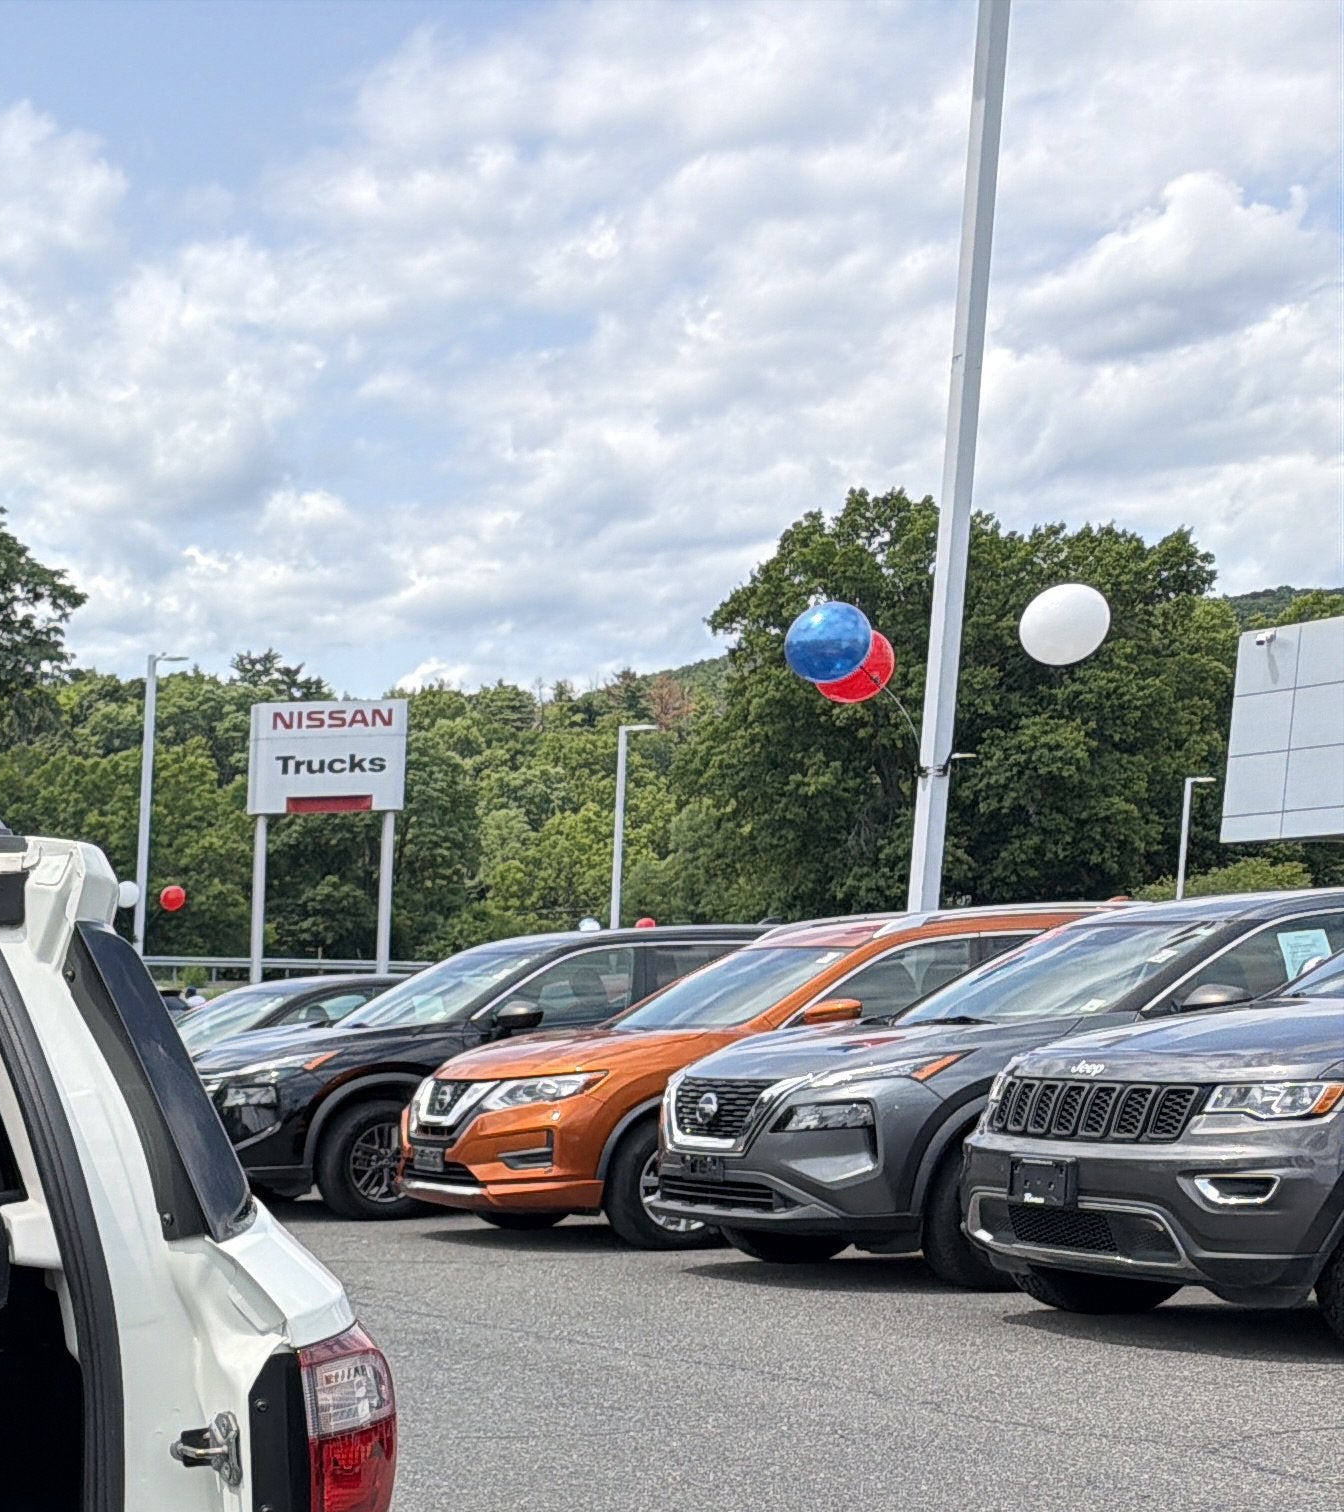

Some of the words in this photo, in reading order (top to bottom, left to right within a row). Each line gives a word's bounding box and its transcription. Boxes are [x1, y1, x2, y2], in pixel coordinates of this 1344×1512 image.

[272, 708, 394, 731] NISSAN
[275, 754, 387, 776] Trucks
[1070, 1059, 1105, 1077] Jeep
